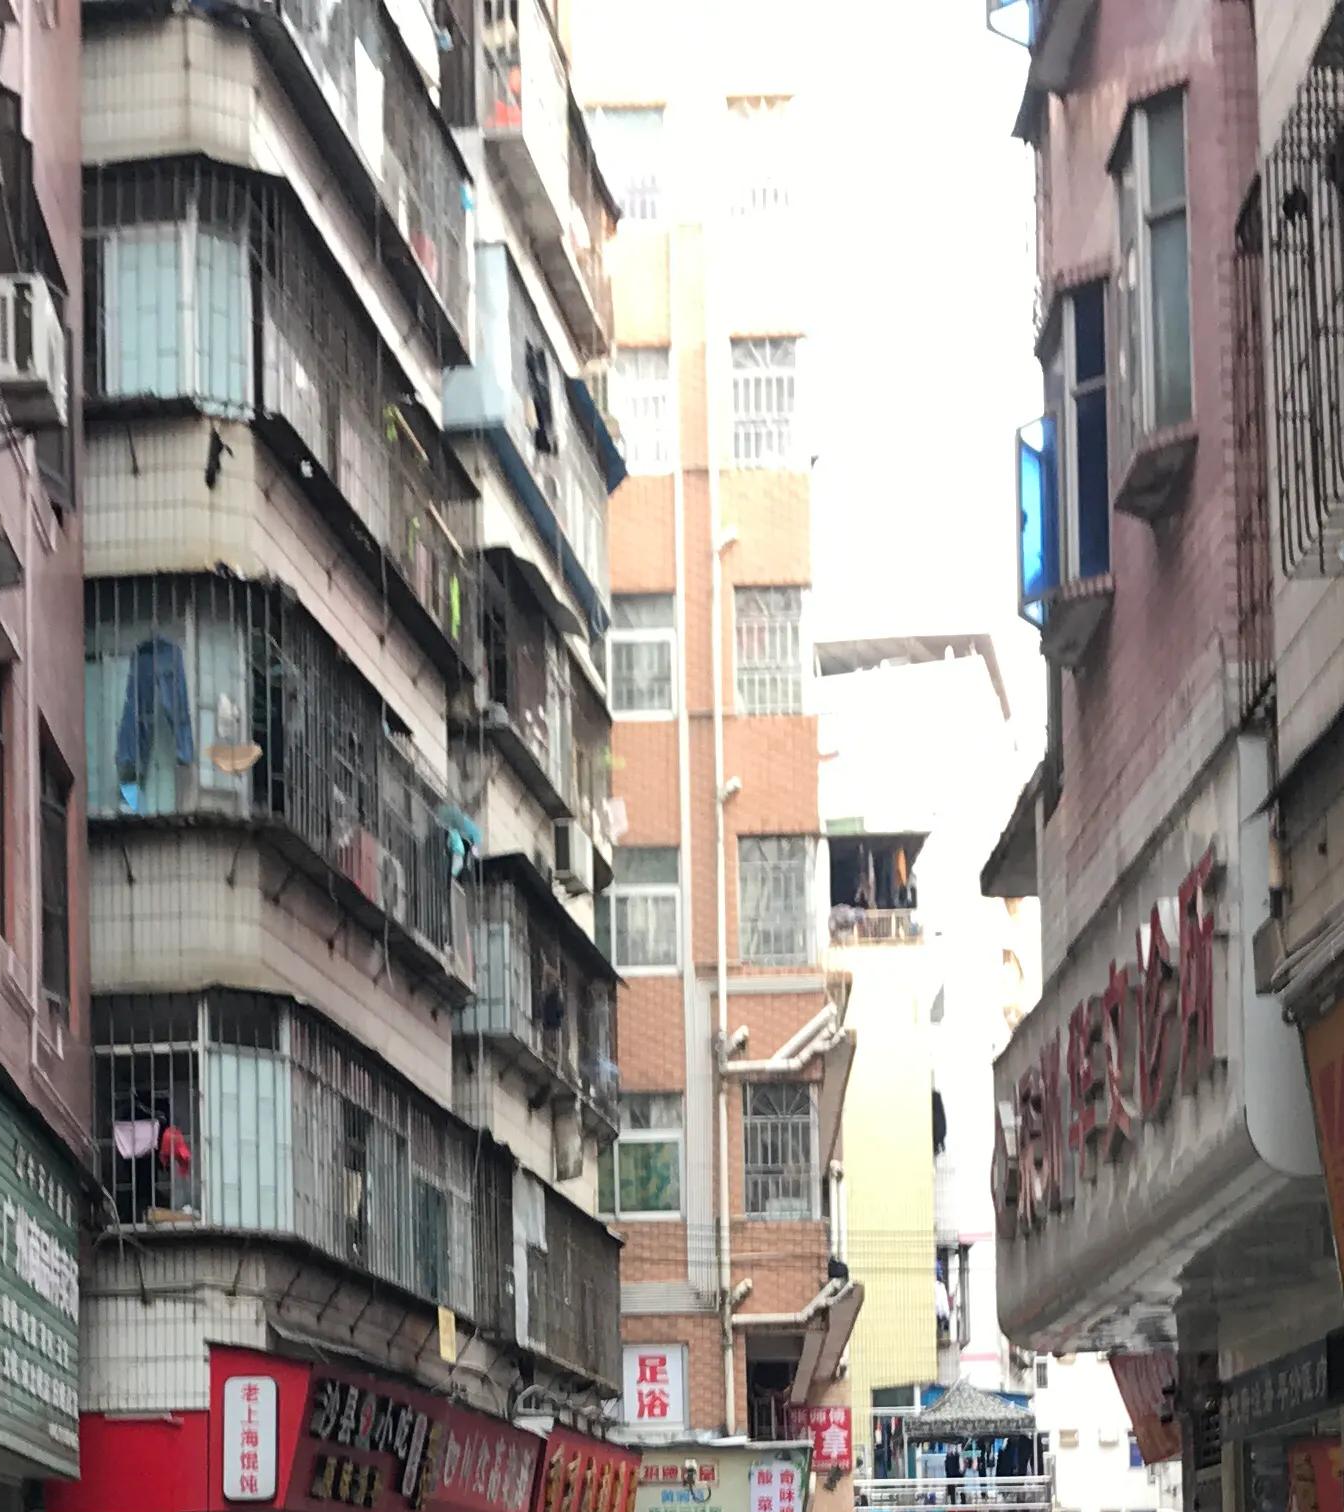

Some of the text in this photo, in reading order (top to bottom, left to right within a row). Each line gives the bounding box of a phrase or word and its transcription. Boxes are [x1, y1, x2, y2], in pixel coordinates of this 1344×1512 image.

[637, 1354, 669, 1418] 足浴
[240, 1384, 261, 1494] 老上海馄饨
